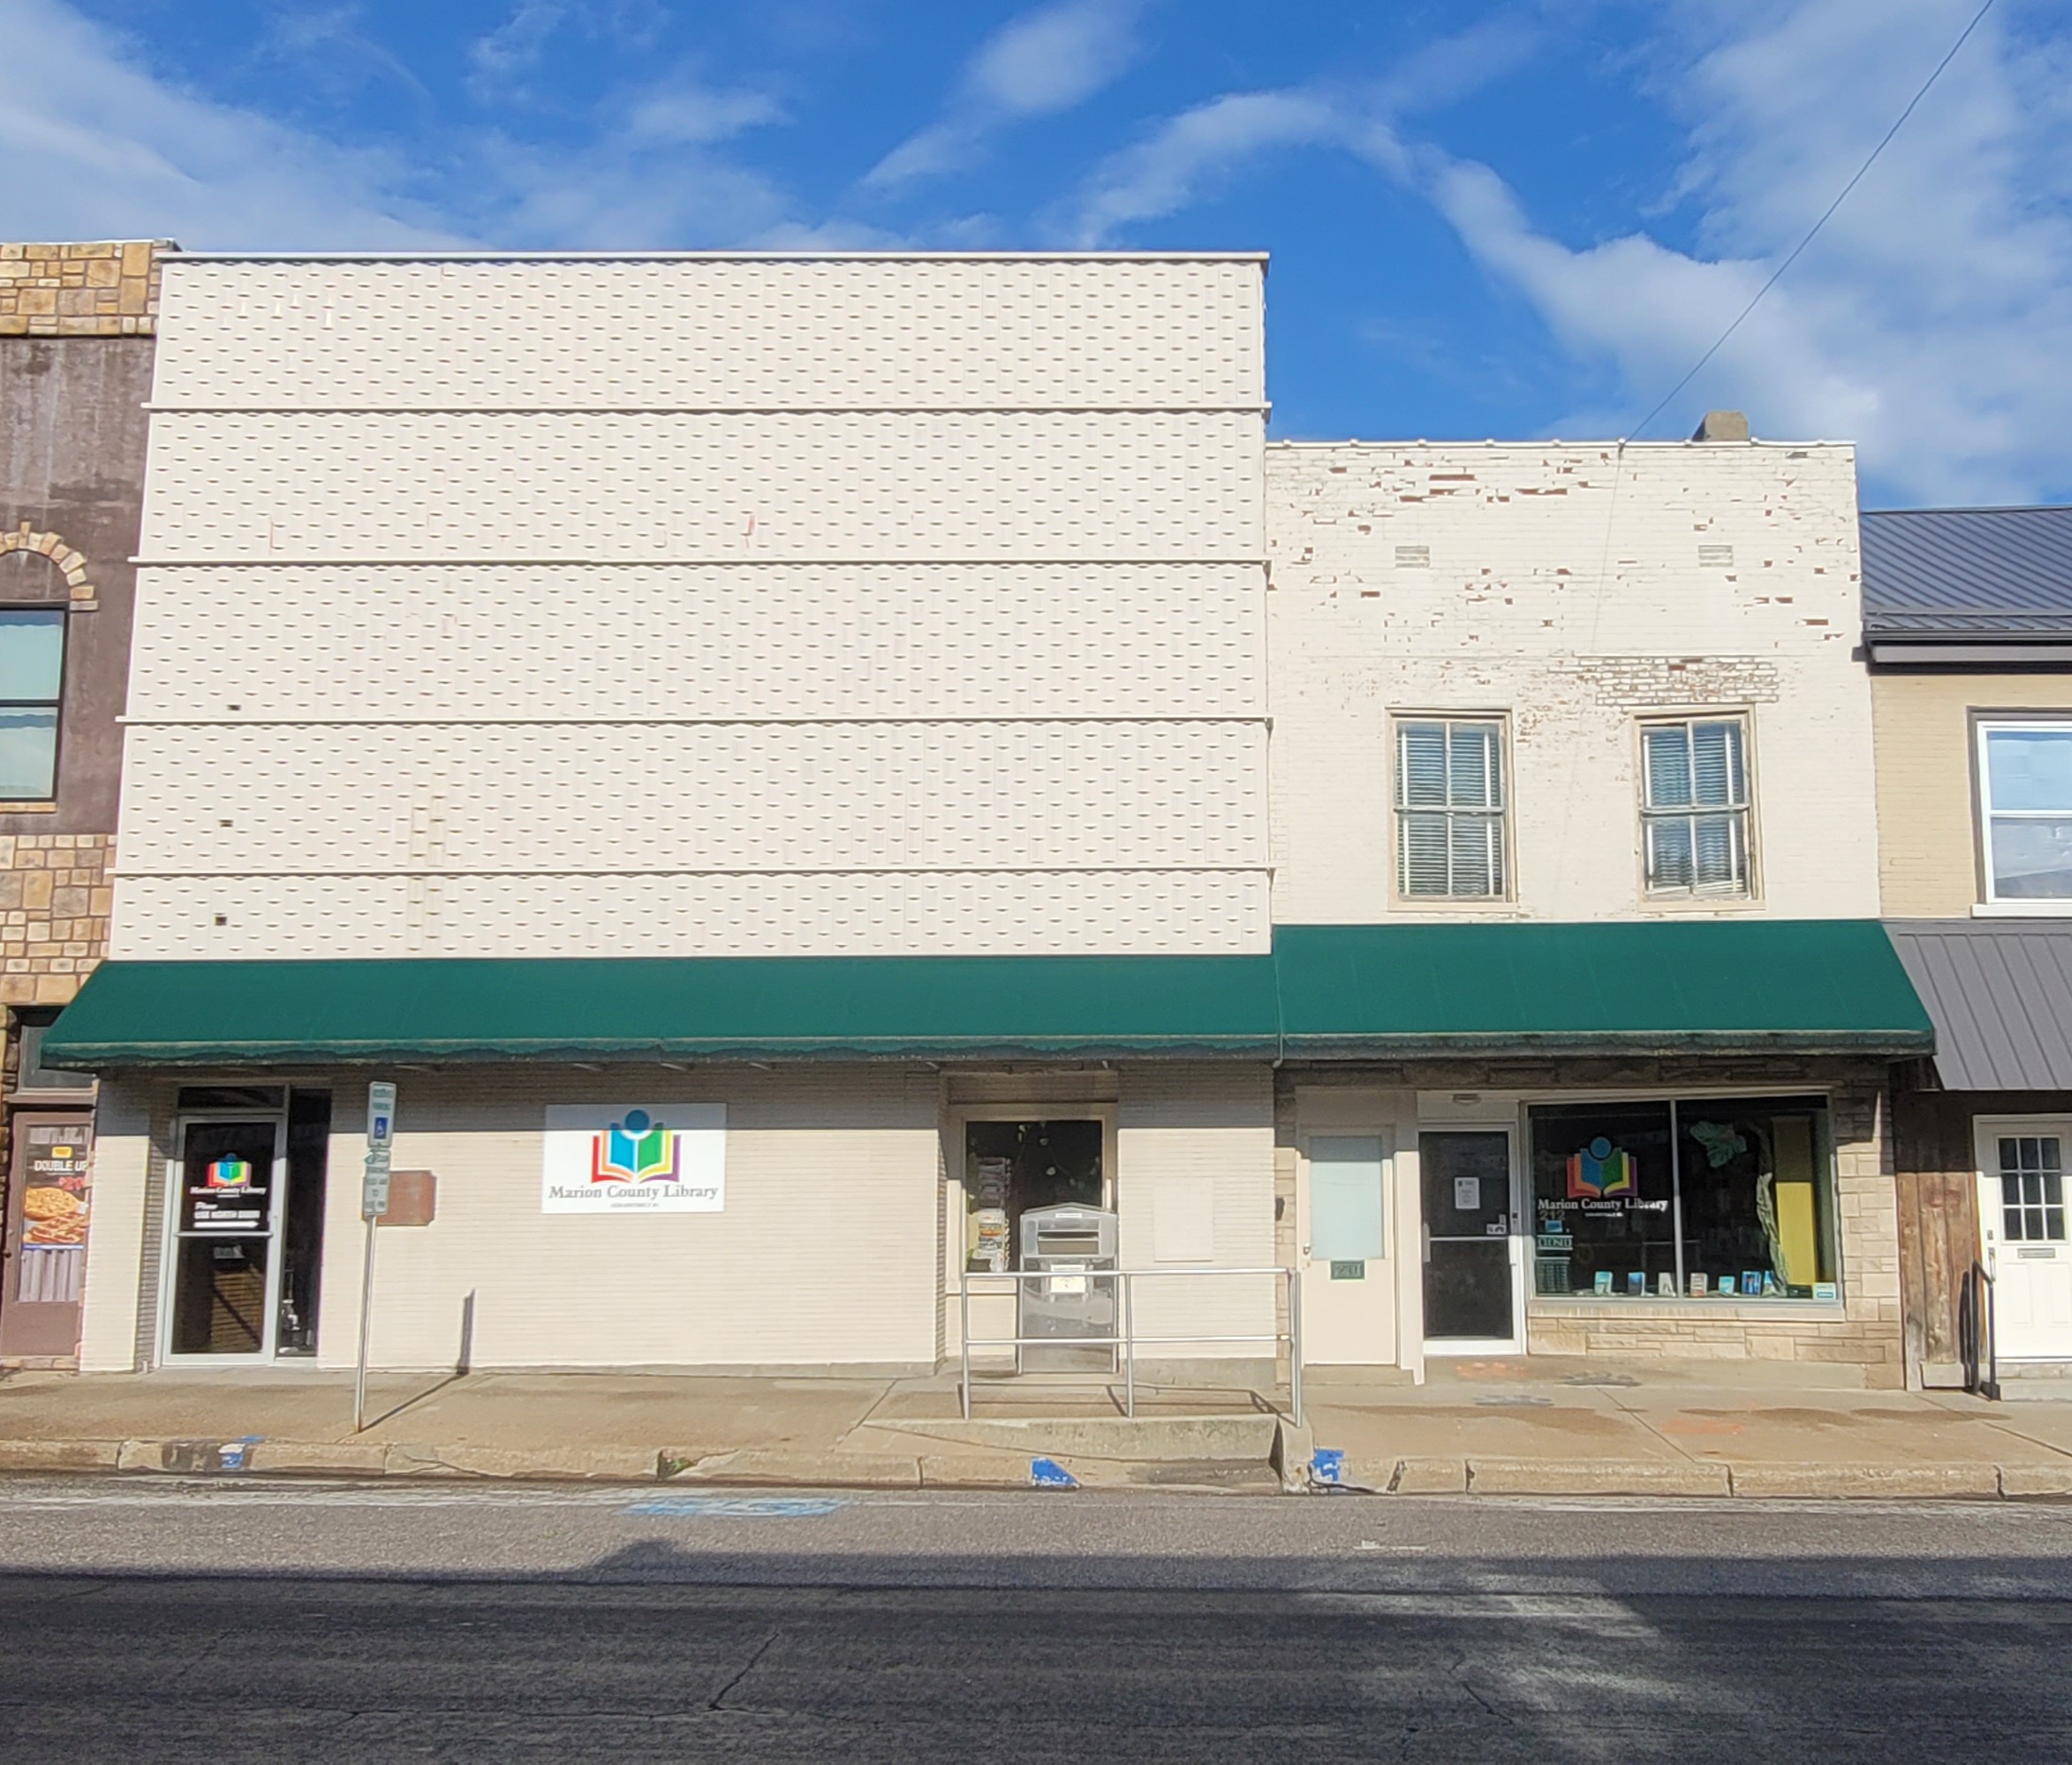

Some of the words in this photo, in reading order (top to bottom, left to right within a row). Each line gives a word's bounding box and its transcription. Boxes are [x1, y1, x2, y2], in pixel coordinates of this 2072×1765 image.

[34, 1160, 74, 1172] DOUBLE
[549, 1185, 603, 1199] Marion
[608, 1185, 659, 1201] County
[662, 1185, 719, 1200] Library
[1538, 1199, 1579, 1210] Marion
[1581, 1198, 1622, 1212] County
[1625, 1198, 1669, 1213] Library
